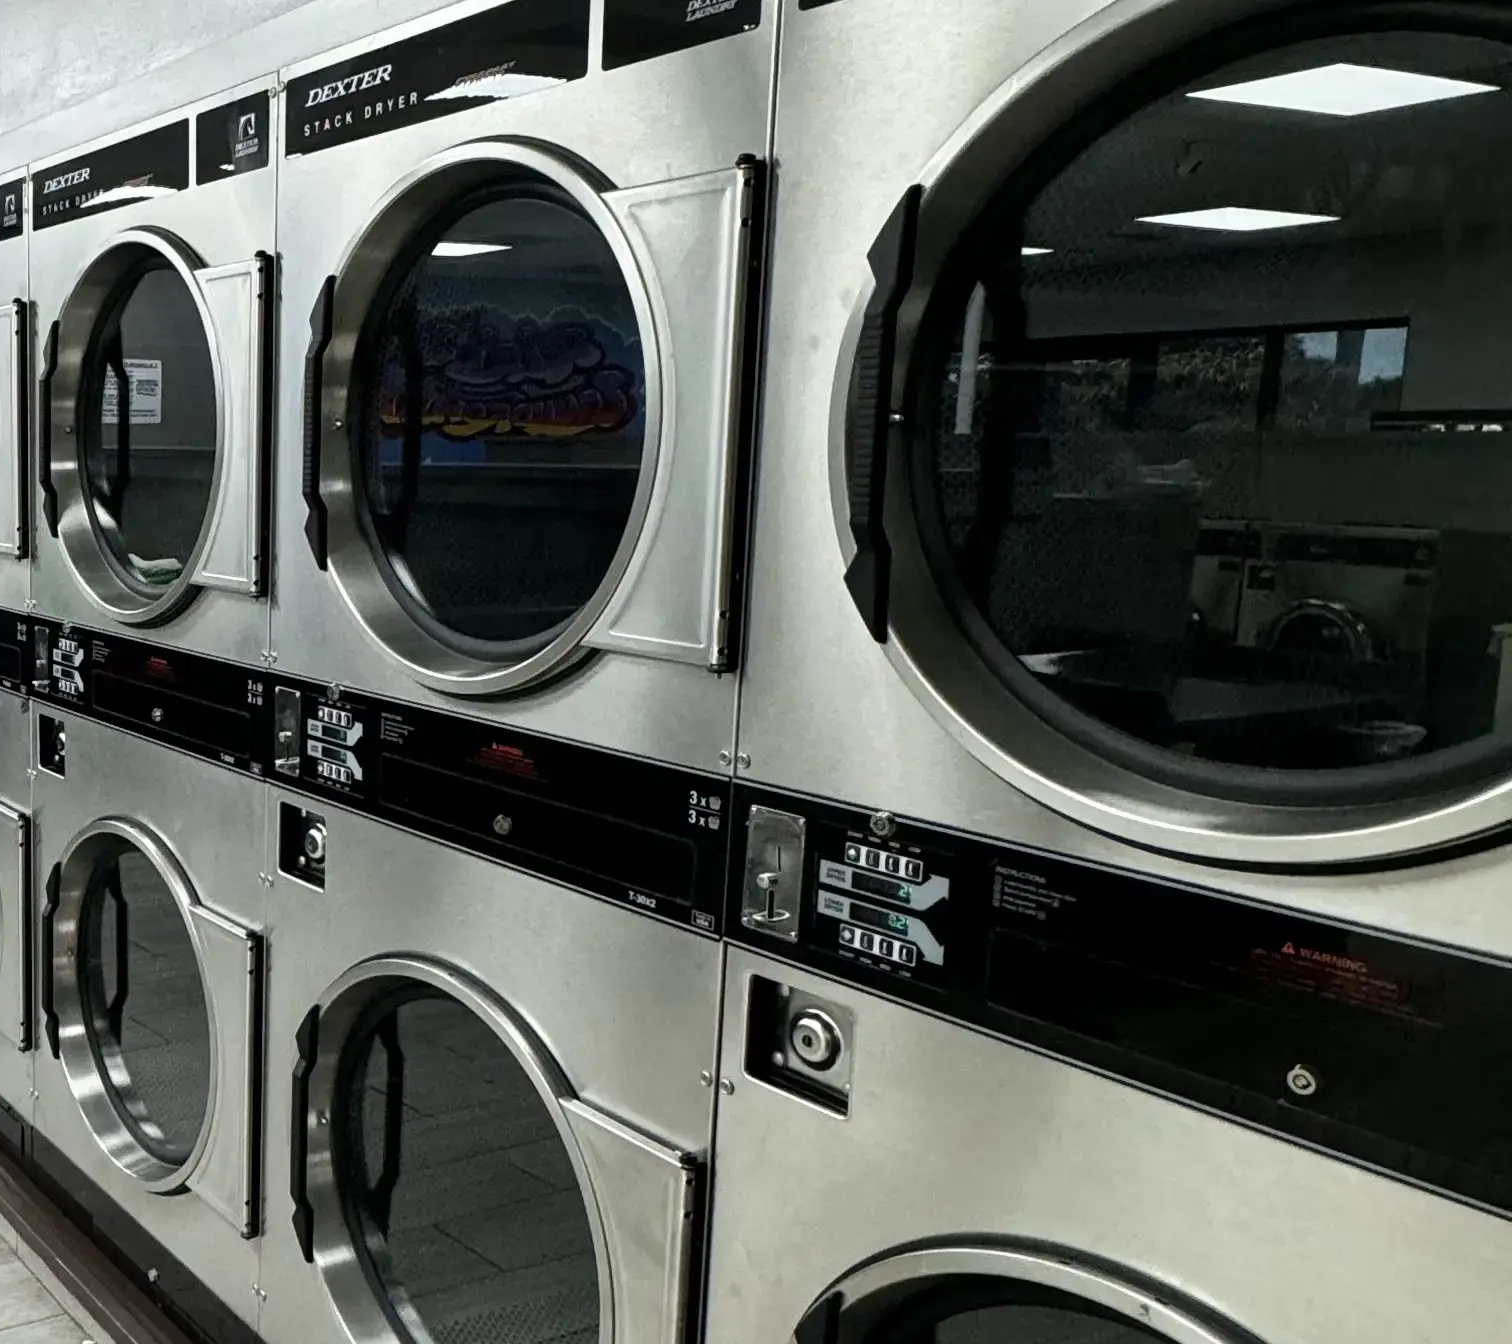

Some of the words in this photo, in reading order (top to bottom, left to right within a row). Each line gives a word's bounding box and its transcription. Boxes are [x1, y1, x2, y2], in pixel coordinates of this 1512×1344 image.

[304, 64, 393, 107] DEXTER
[303, 111, 353, 136] STACK
[364, 92, 418, 119] DRYER
[43, 168, 90, 194] DEXTER
[42, 198, 71, 216] STACK
[689, 790, 698, 804] 3
[688, 810, 697, 824] 3
[1300, 947, 1368, 973] WARNING
